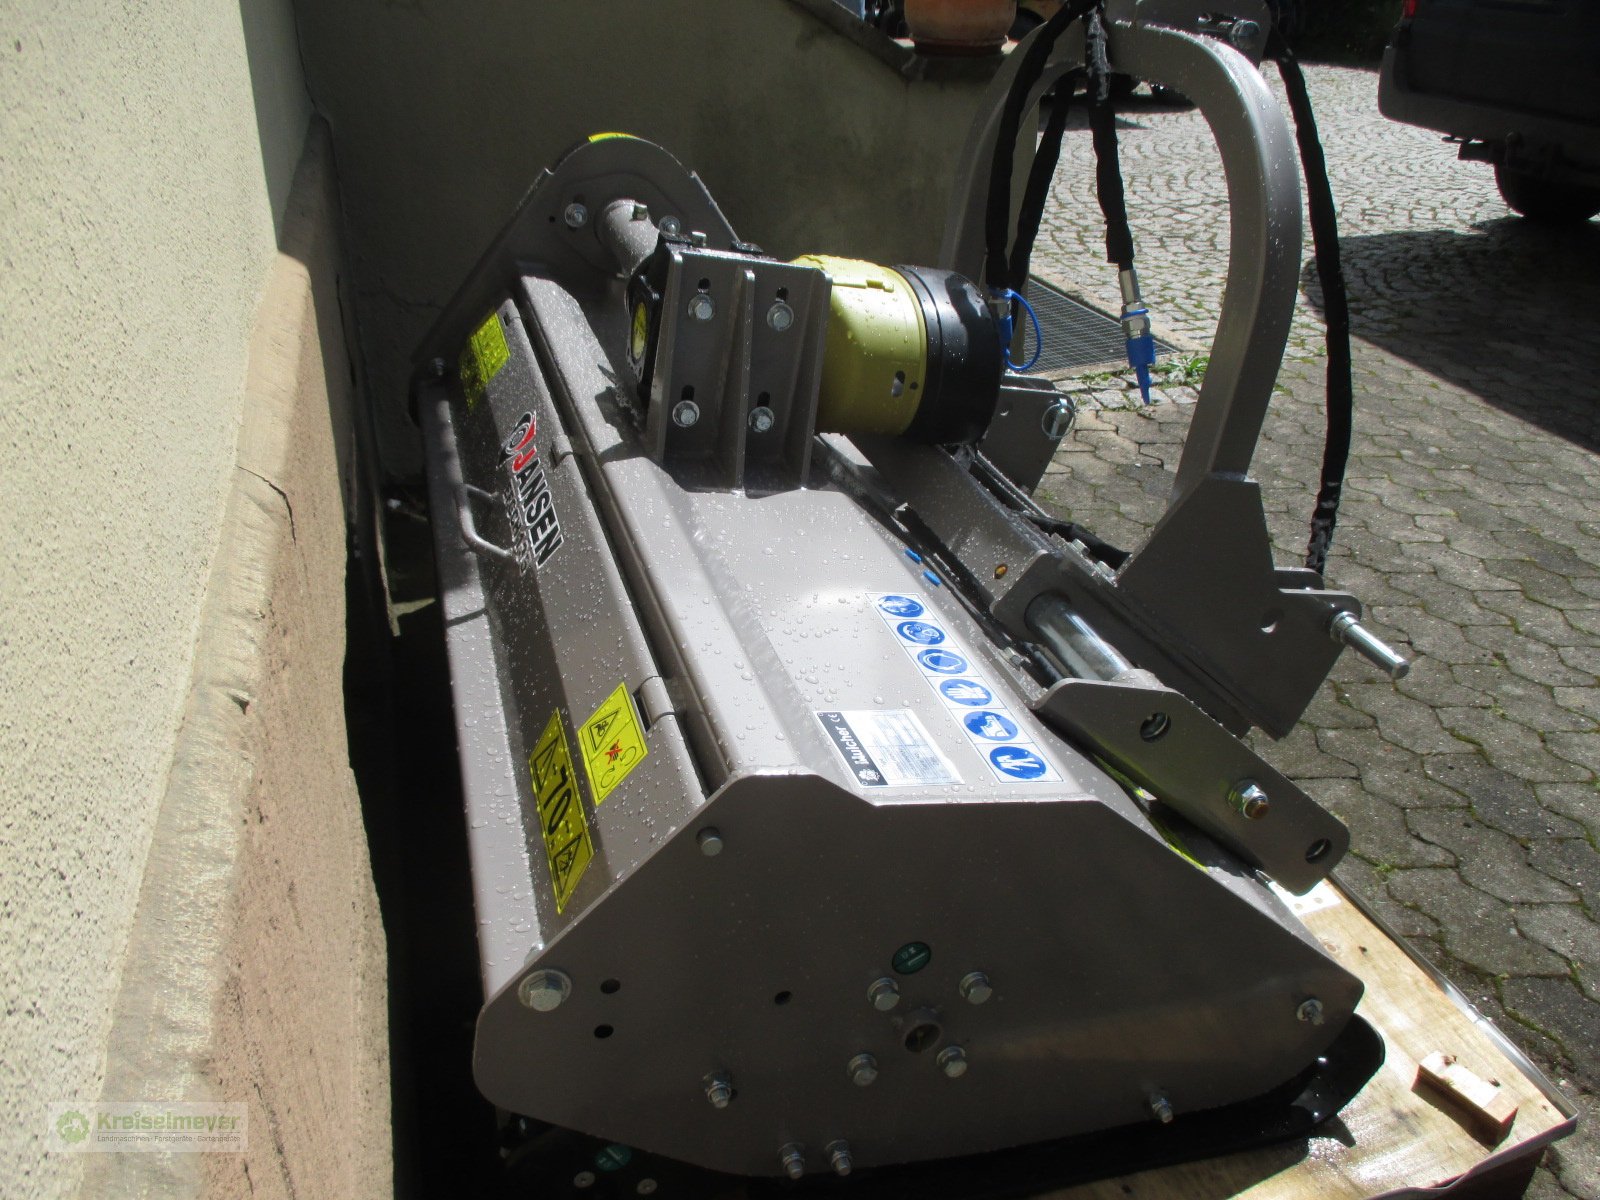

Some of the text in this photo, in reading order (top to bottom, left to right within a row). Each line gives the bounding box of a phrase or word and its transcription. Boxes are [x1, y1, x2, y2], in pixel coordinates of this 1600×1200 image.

[512, 445, 565, 570] JANSEN
[834, 725, 870, 765] Mulcher
[543, 763, 572, 836] 70
